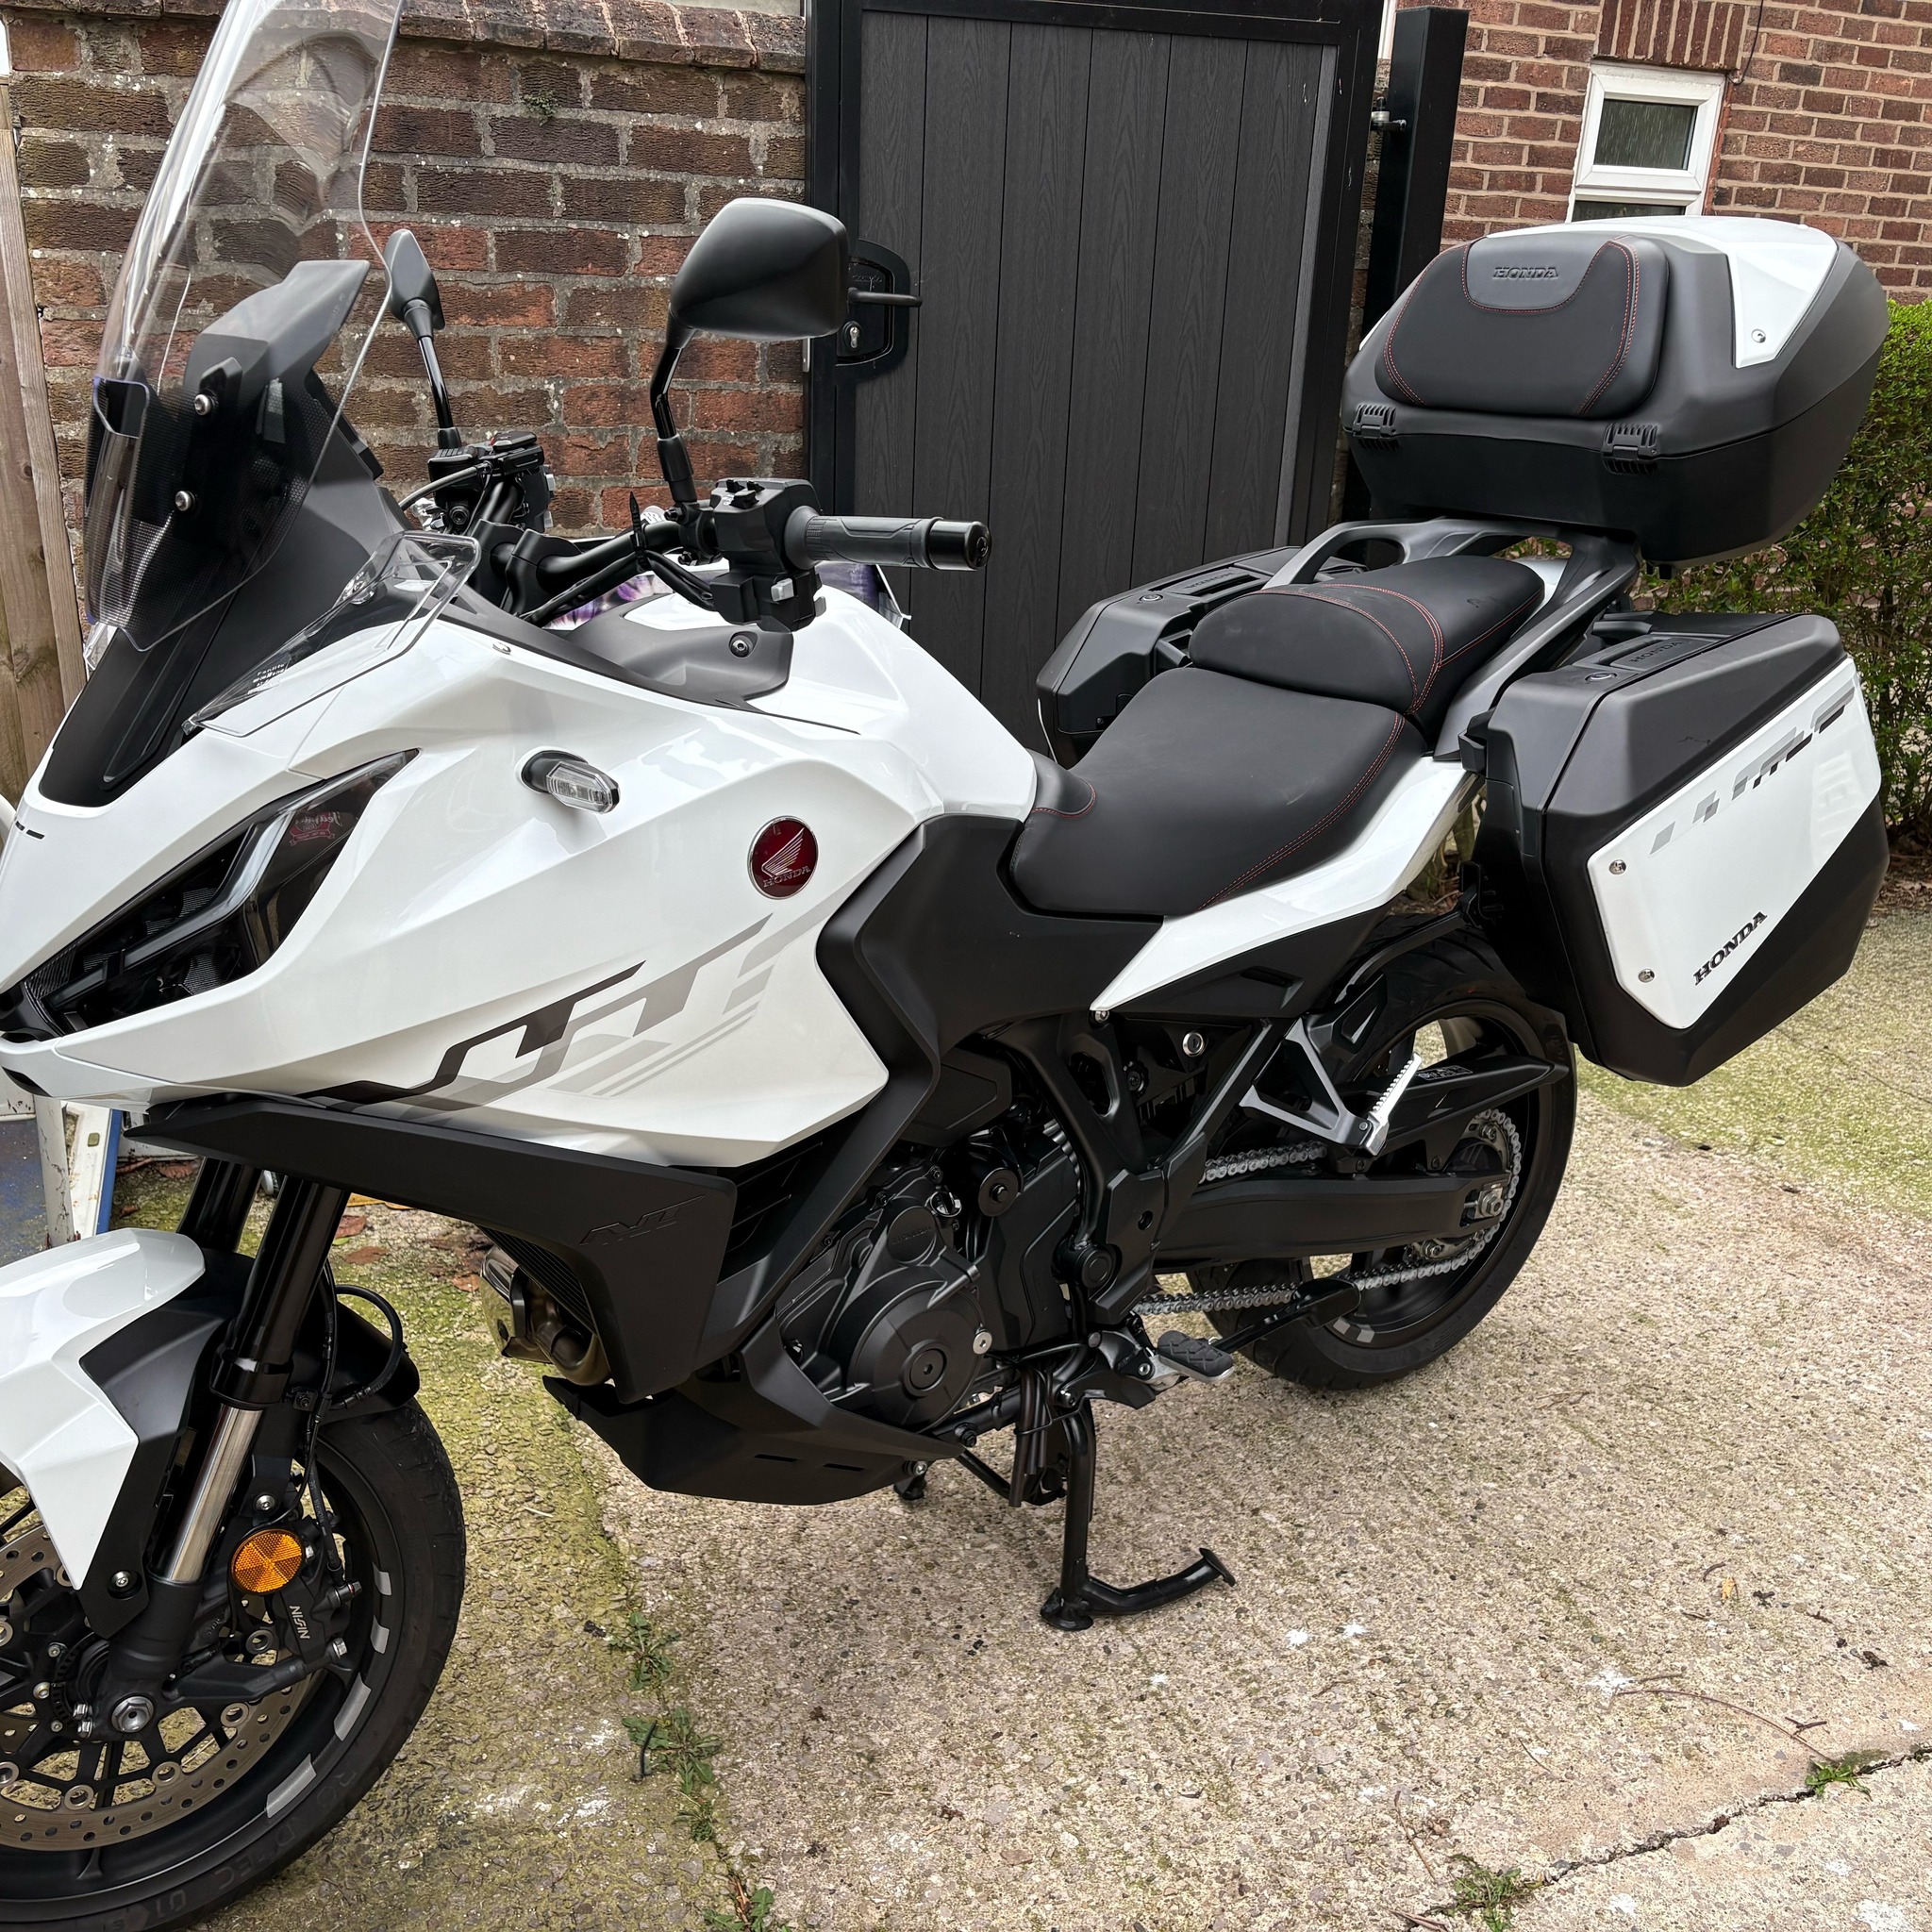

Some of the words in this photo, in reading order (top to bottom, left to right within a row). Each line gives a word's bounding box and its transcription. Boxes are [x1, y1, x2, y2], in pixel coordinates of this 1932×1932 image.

[1491, 266, 1559, 280] HONDA
[762, 865, 811, 888] HONDA
[1692, 911, 1768, 986] HONDA
[289, 1605, 311, 1640] NISSIN
